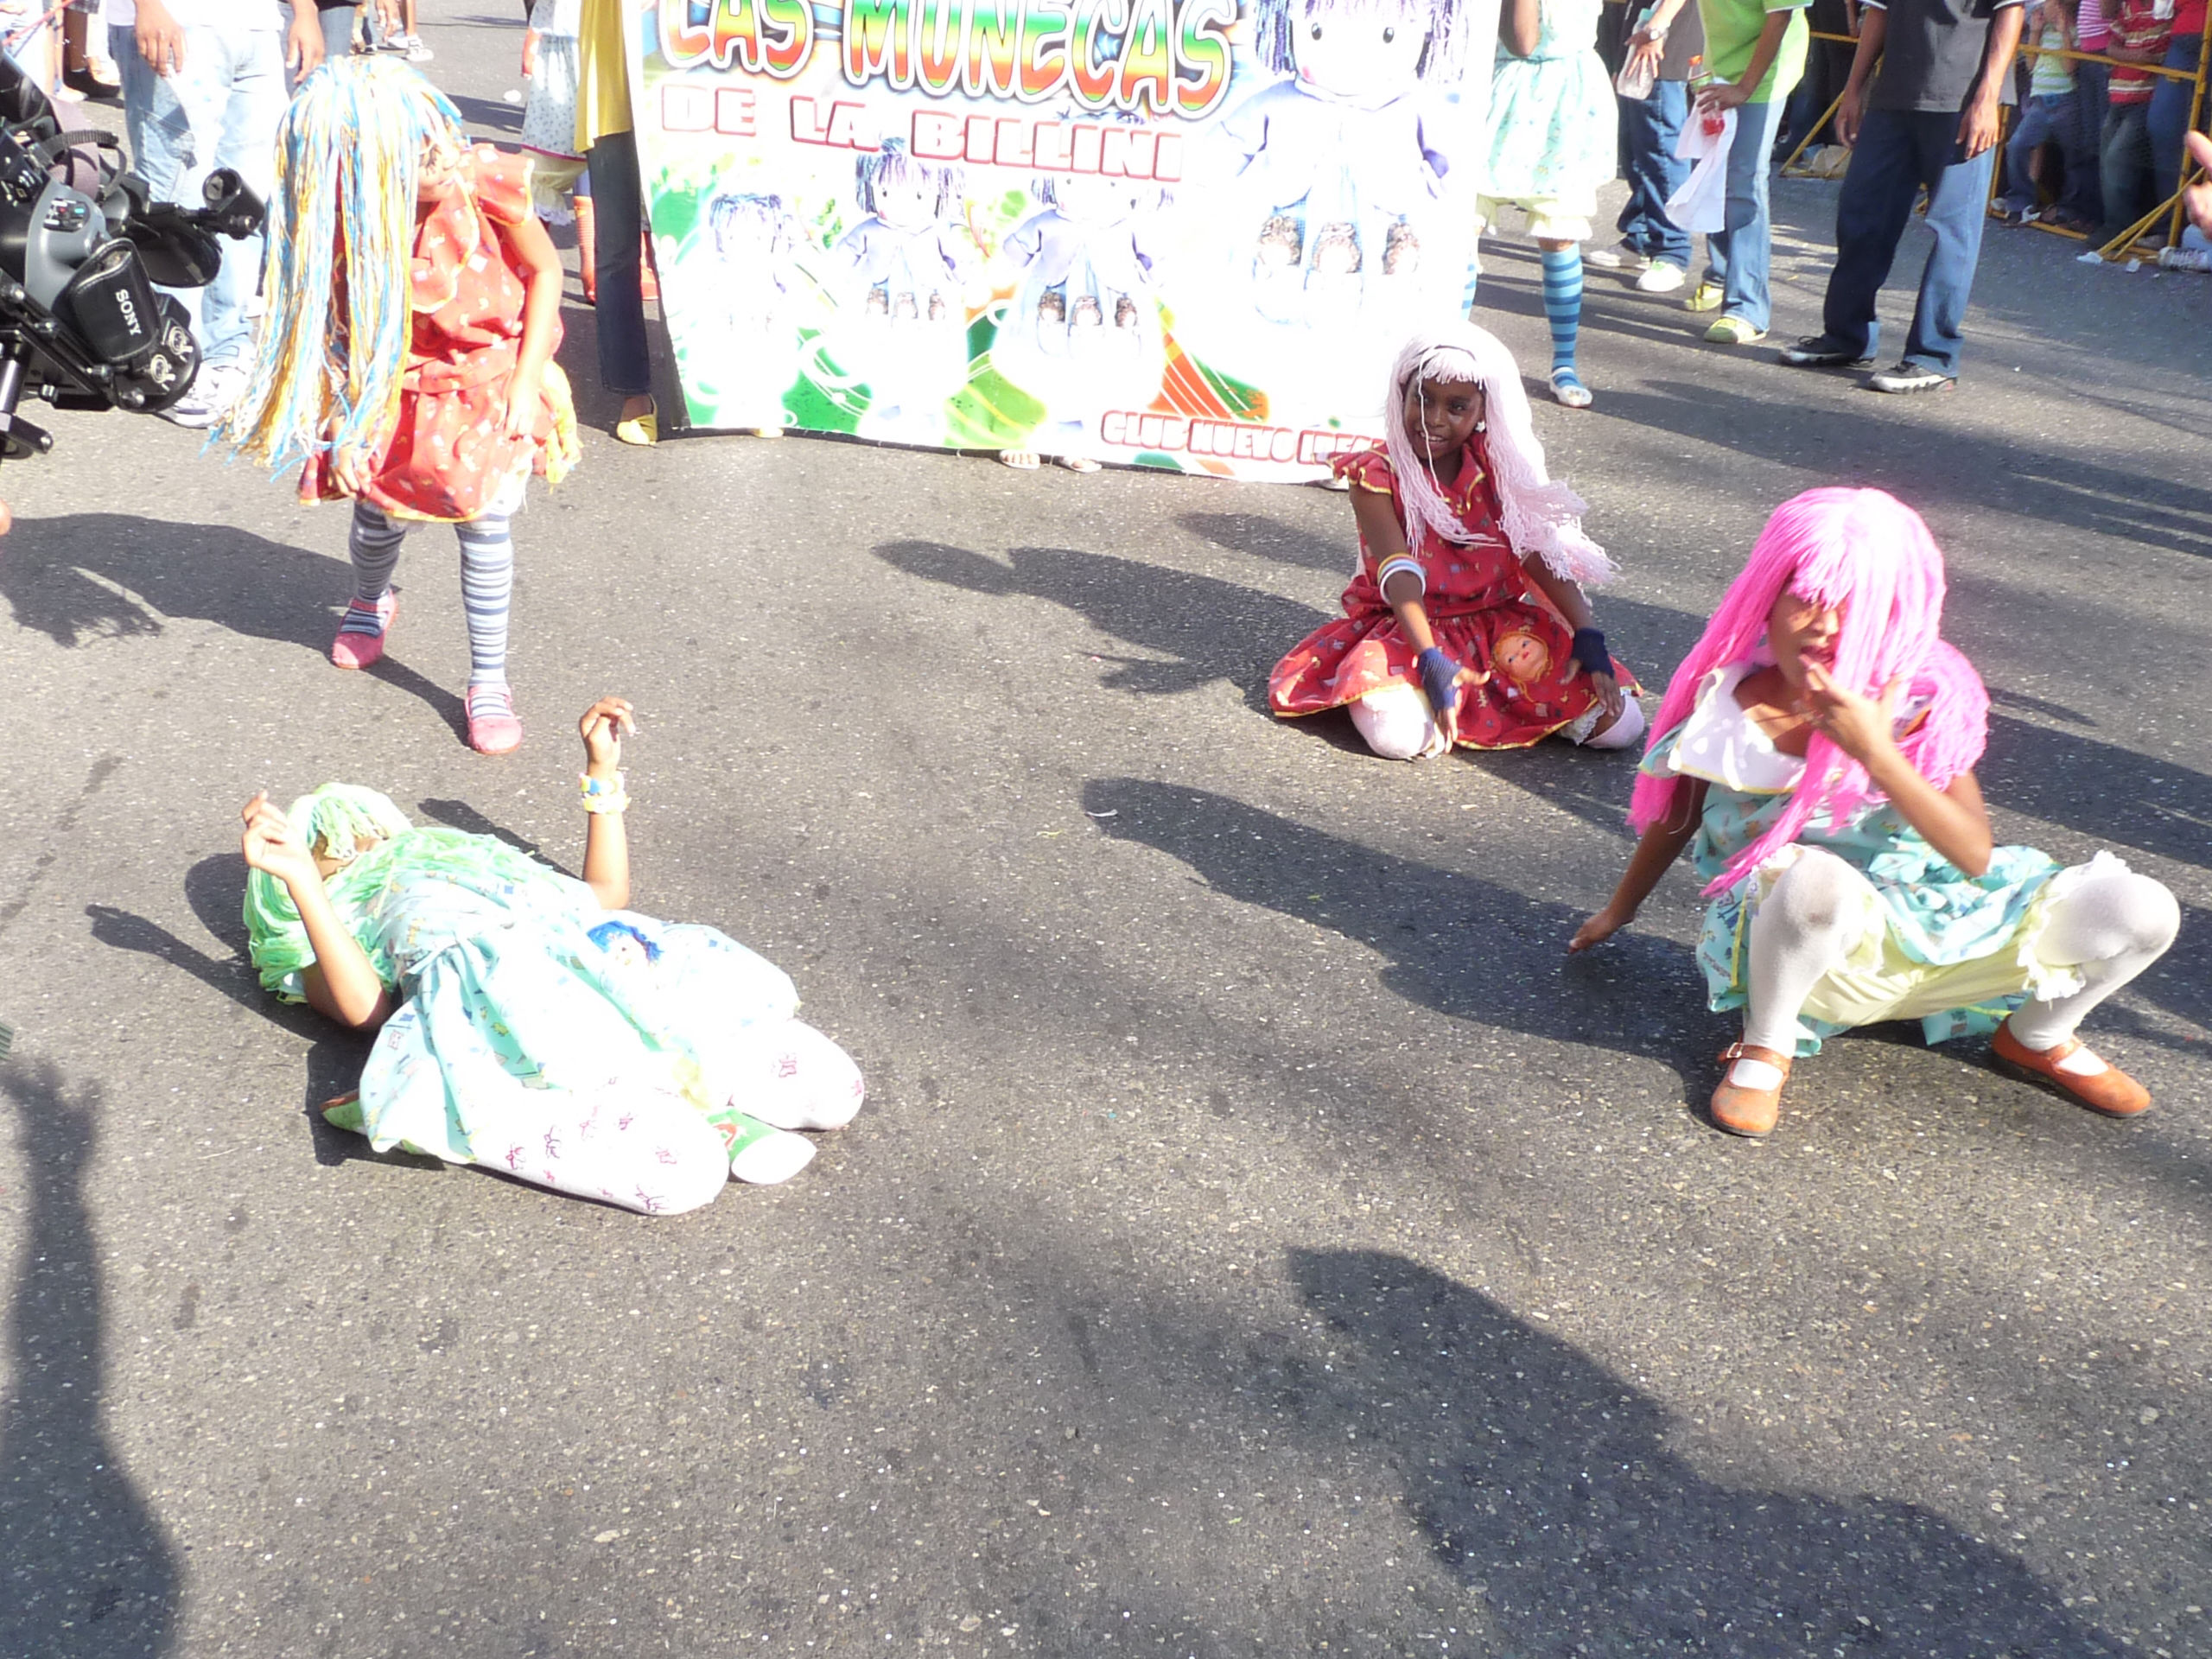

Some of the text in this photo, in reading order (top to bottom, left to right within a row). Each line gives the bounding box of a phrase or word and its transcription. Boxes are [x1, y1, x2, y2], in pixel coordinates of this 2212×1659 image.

[660, 0, 813, 78] LAS
[662, 85, 1183, 181] DE LA BILLINI
[115, 289, 142, 336] SONY
[1101, 410, 1190, 451] CLUB
[1187, 418, 1294, 462] NUEVO
